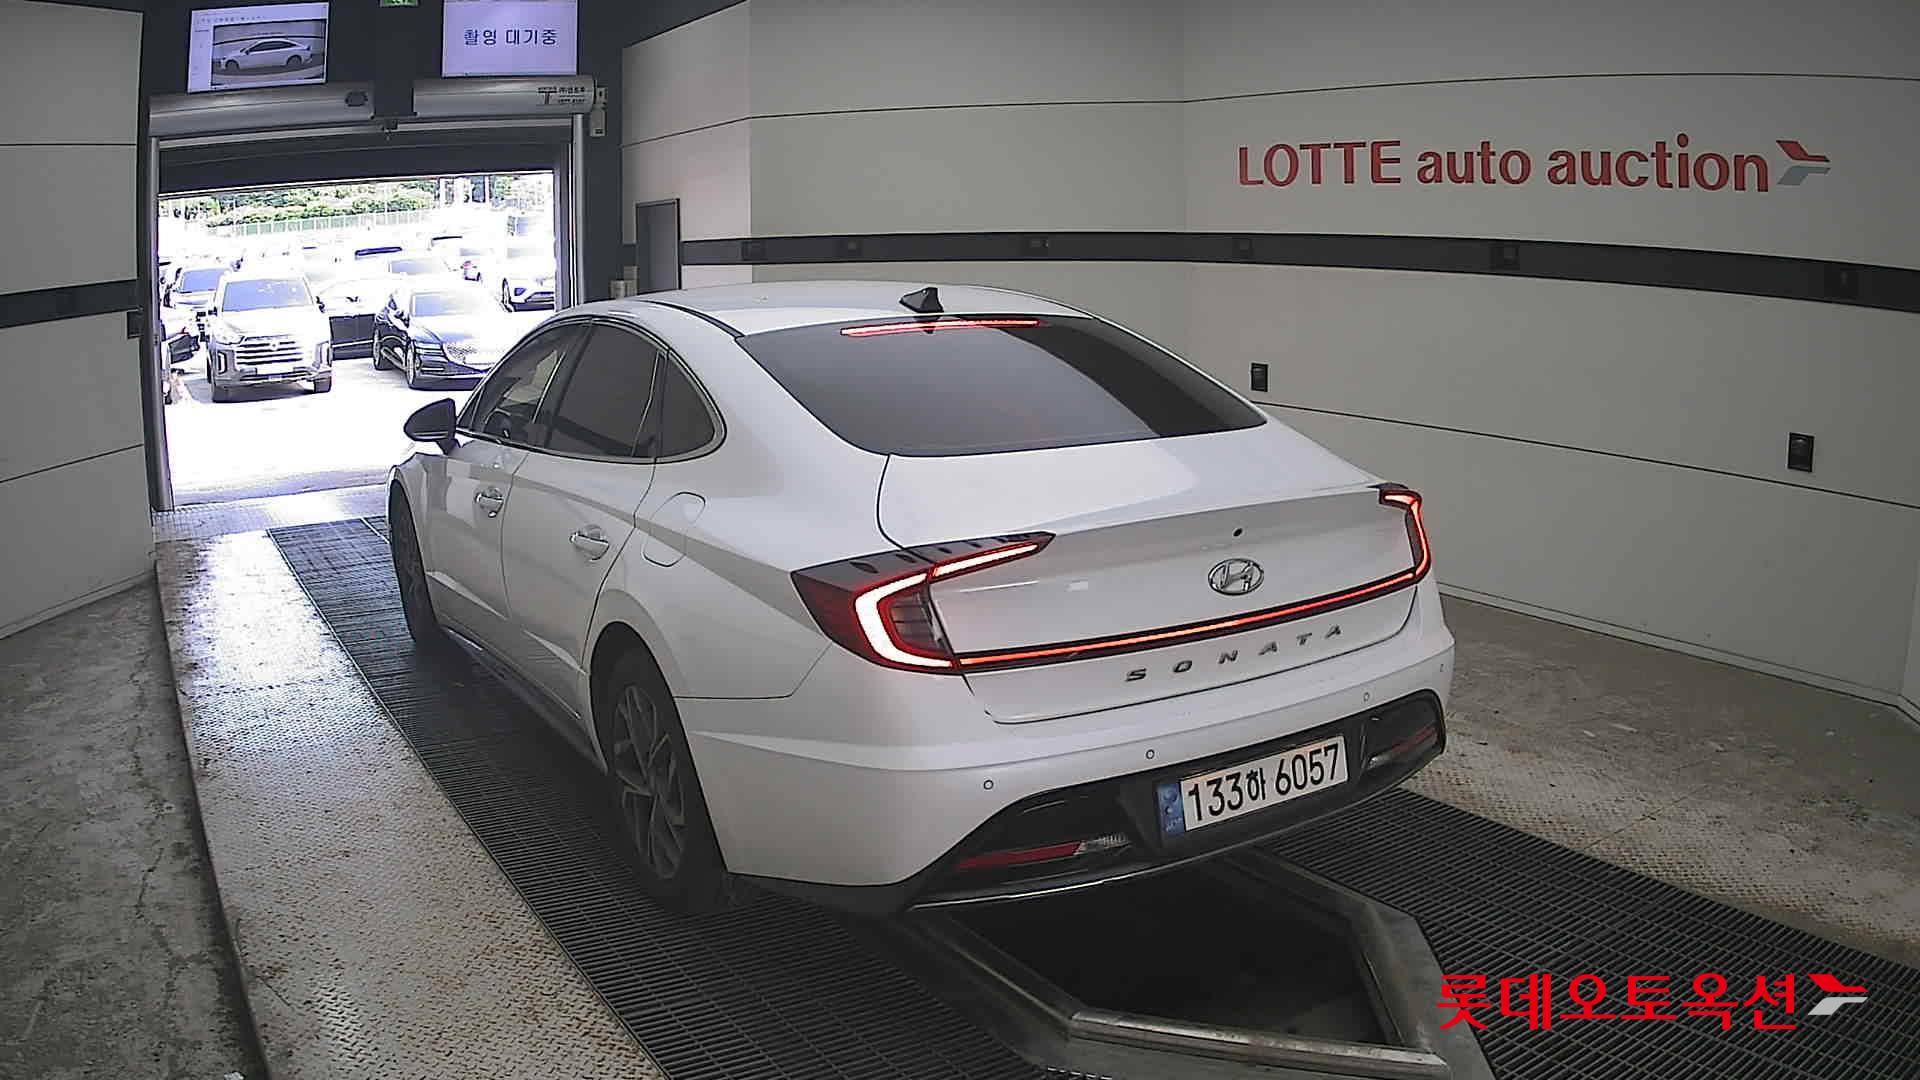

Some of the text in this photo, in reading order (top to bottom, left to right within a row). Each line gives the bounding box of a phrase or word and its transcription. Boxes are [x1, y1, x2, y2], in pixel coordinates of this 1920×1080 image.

[464, 29, 558, 46] 촬영 대기중
[1239, 133, 1769, 192] LOTTE auto auction
[1126, 626, 1342, 682] SONATA
[1188, 743, 1339, 822] 133하 6057
